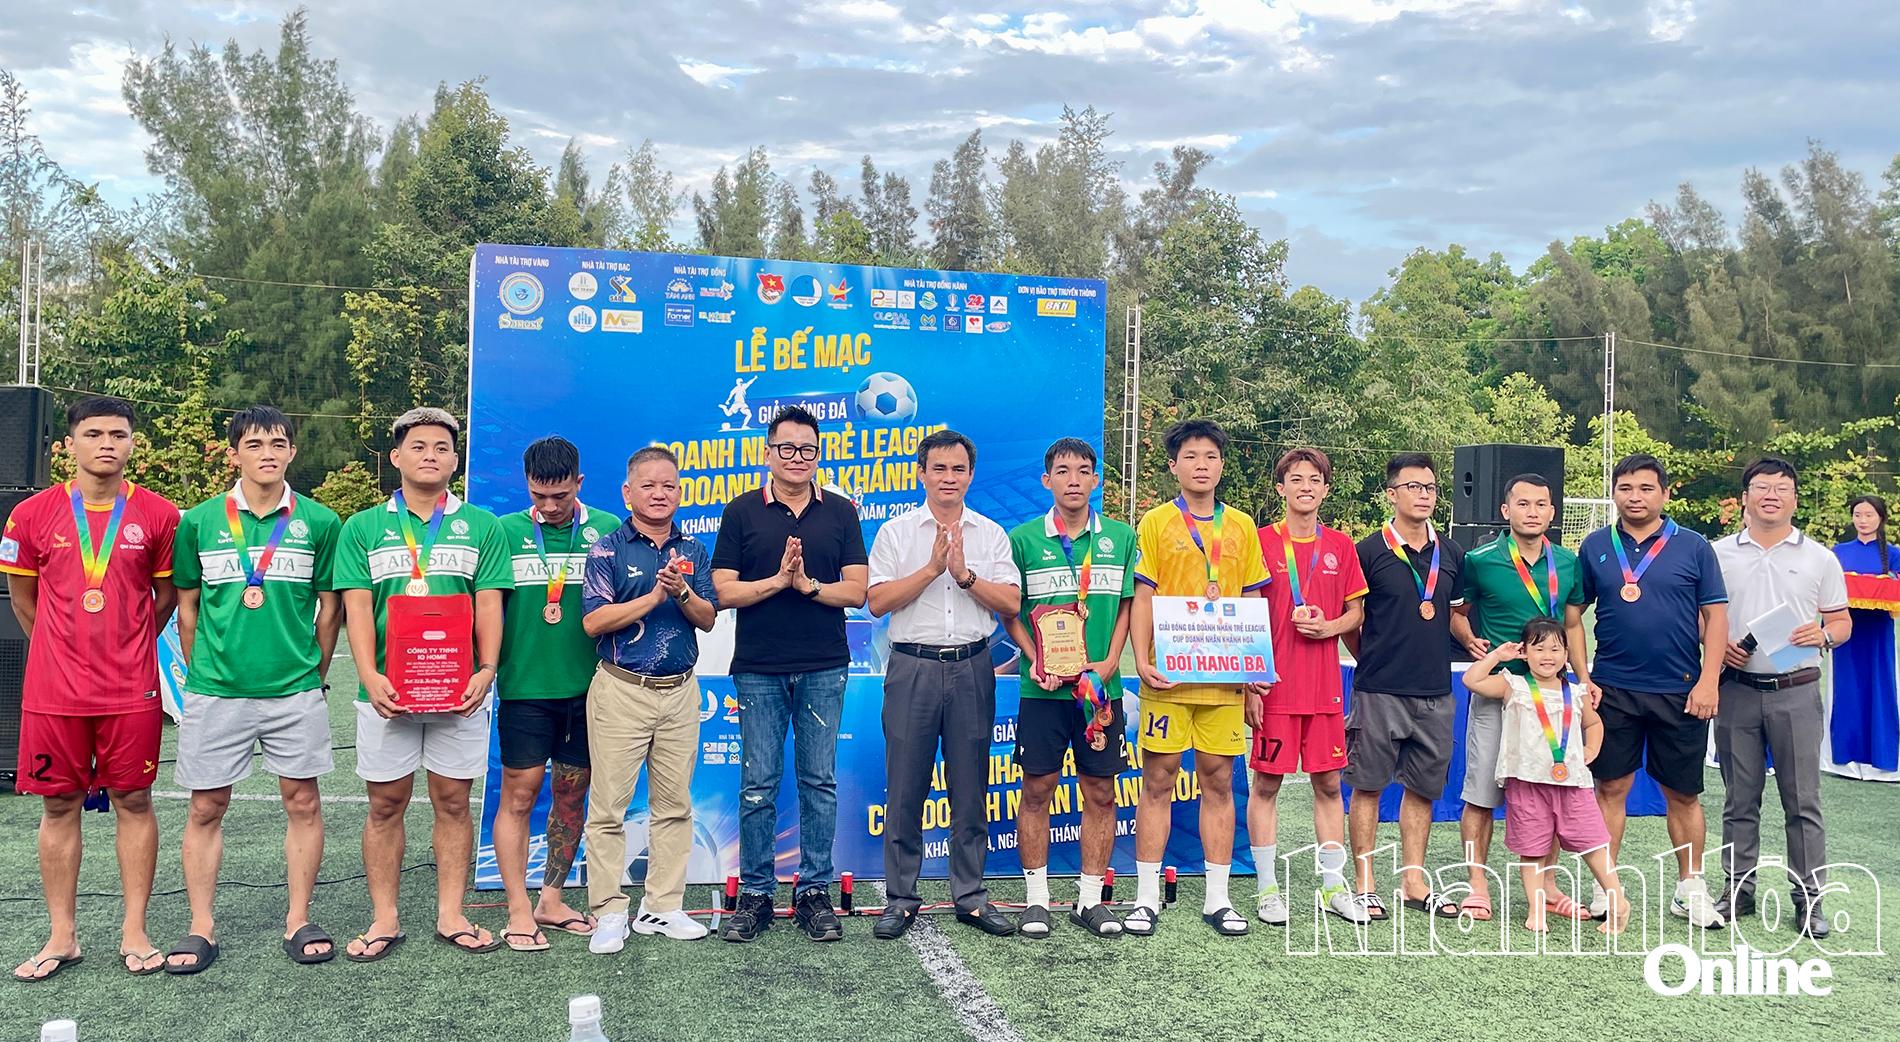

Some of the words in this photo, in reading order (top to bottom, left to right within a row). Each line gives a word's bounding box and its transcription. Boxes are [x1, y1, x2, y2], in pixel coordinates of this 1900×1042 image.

[582, 260, 594, 269] NHÀ
[674, 266, 686, 275] NHÀ
[904, 279, 915, 288] NHÀ
[735, 326, 767, 373] LỄ
[773, 326, 814, 370] BẾ
[814, 332, 872, 373] MẠC
[758, 400, 786, 424] GIẢ
[829, 397, 847, 420] ĐÁ
[654, 438, 734, 471] OANH
[818, 421, 856, 461] TRẺ
[861, 425, 947, 459] LEAG
[838, 458, 917, 495] KHÁNH
[681, 515, 721, 534] KHÁNH
[860, 504, 886, 521] NĂM
[387, 552, 459, 569] ARSTA
[1048, 573, 1109, 589] ARTITA
[1185, 635, 1204, 643] DOANH
[1197, 624, 1216, 632] DOANH
[1245, 624, 1266, 633] LEAGUE
[1165, 653, 1192, 675] ĐỘI
[1196, 655, 1240, 675] HẠNG
[1244, 655, 1266, 672] BA
[993, 718, 1018, 742] GIẢ
[1145, 712, 1169, 739] 14
[1257, 736, 1282, 763] 17
